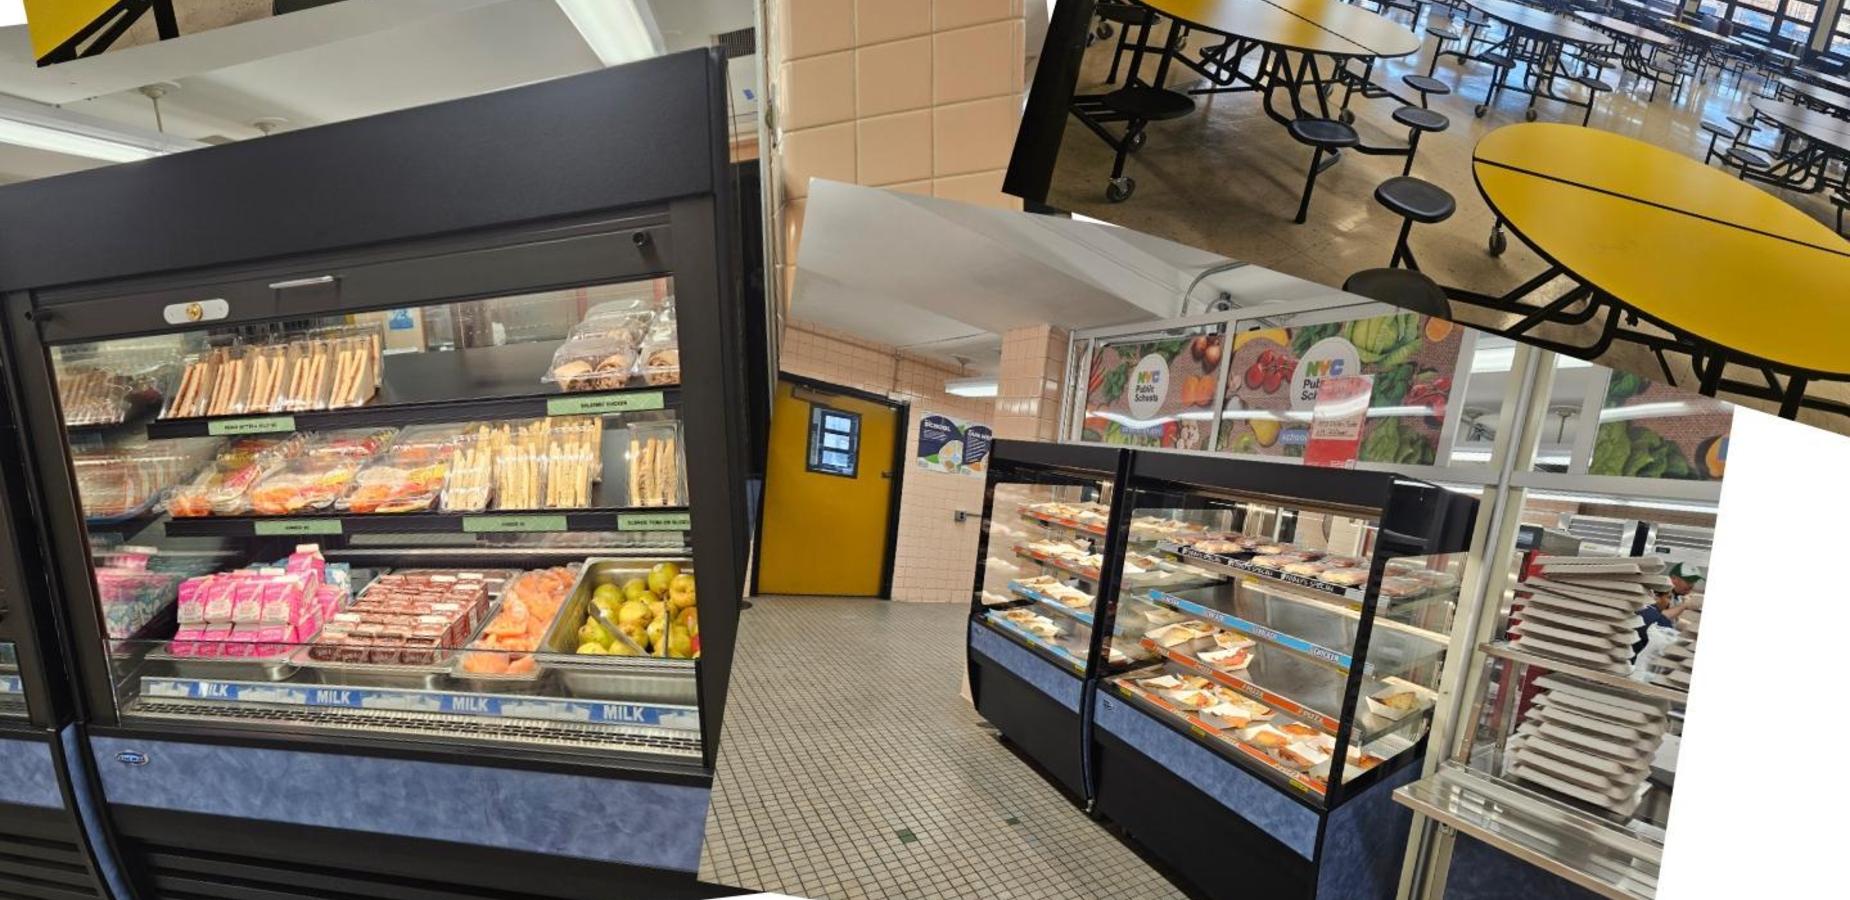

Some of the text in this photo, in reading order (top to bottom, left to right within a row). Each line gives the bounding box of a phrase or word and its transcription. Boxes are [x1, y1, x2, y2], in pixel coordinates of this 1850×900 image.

[1306, 359, 1345, 377] NYC
[1137, 371, 1160, 384] NYC
[316, 690, 351, 705] MILK
[452, 697, 489, 712] MILK
[603, 705, 645, 721] MILK
